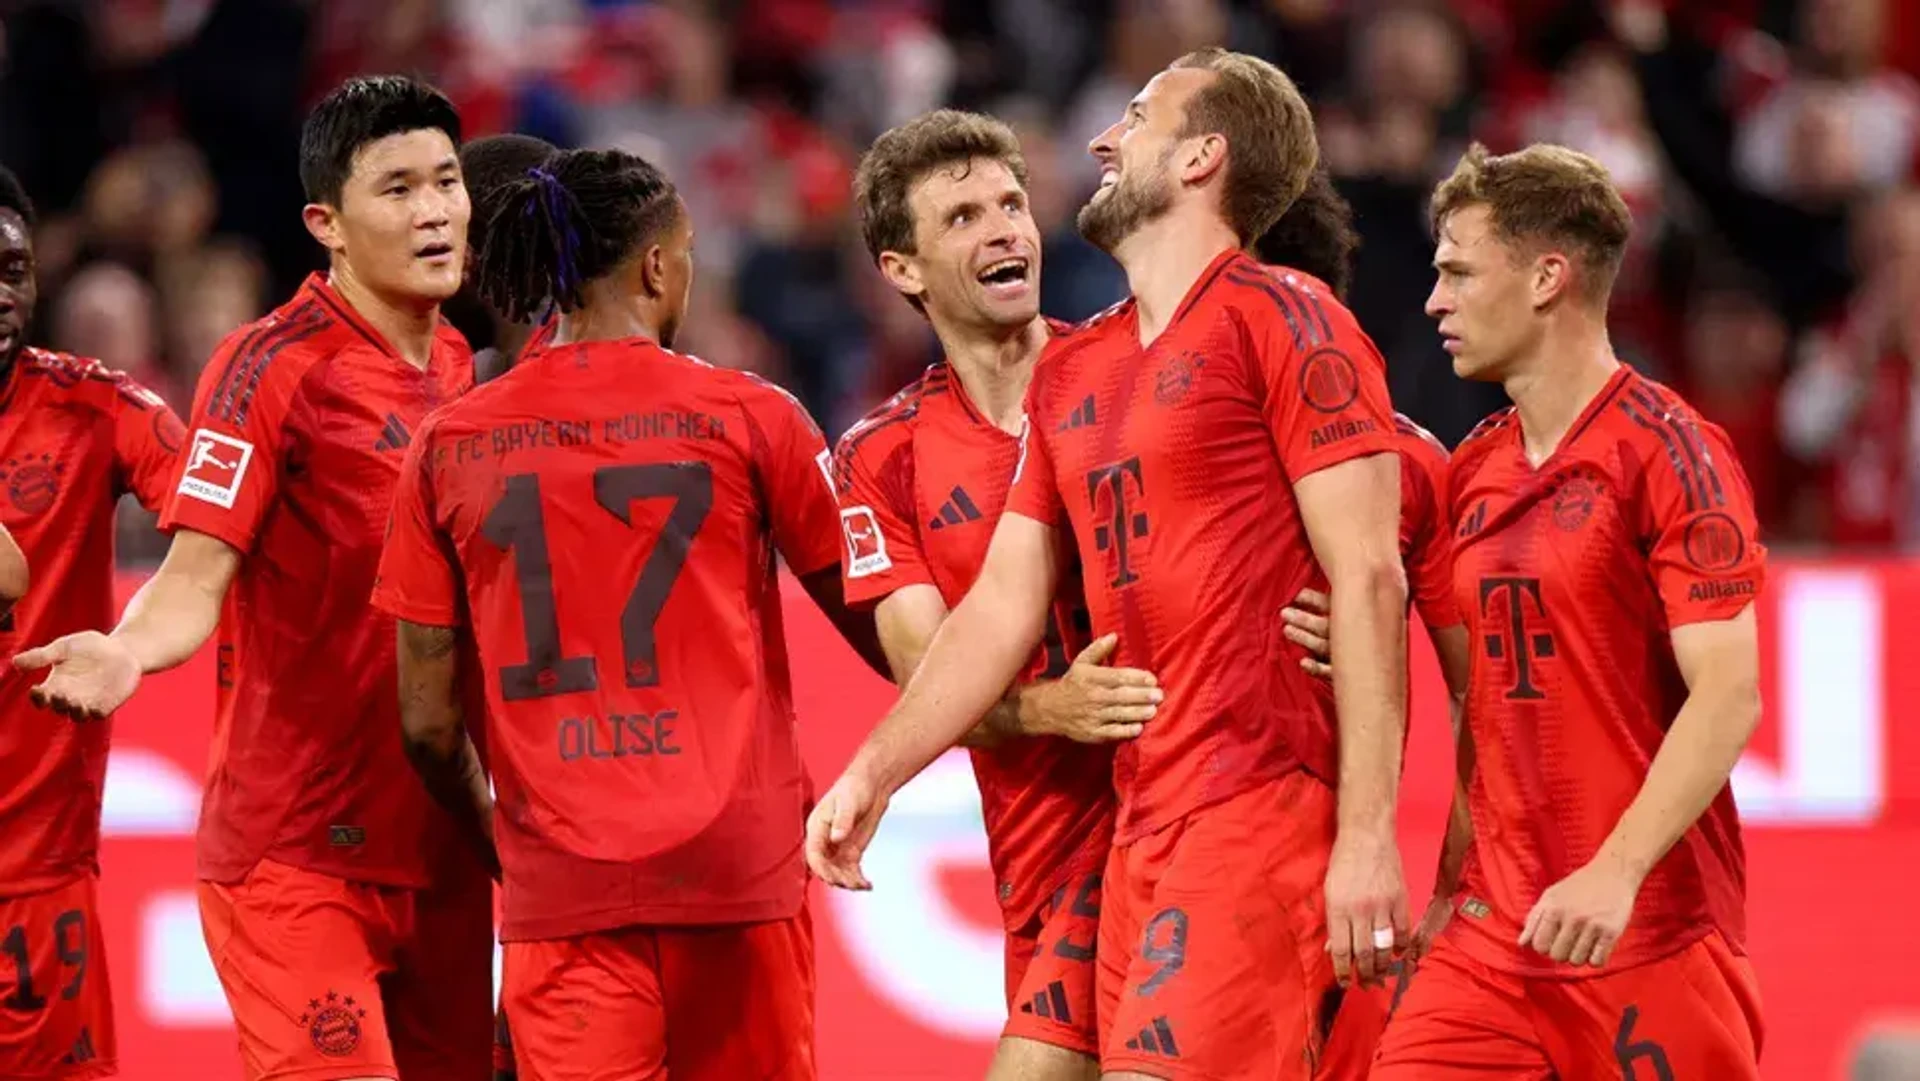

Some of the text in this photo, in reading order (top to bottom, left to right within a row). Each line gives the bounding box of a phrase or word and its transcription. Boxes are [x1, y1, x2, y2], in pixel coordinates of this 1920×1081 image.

[456, 434, 484, 464] FC
[491, 420, 592, 456] BAYERN
[482, 461, 713, 701] 17
[1688, 580, 1755, 602] Allianz
[558, 711, 681, 761] OLISE
[1, 908, 88, 1010] 19
[1137, 907, 1189, 997] 9
